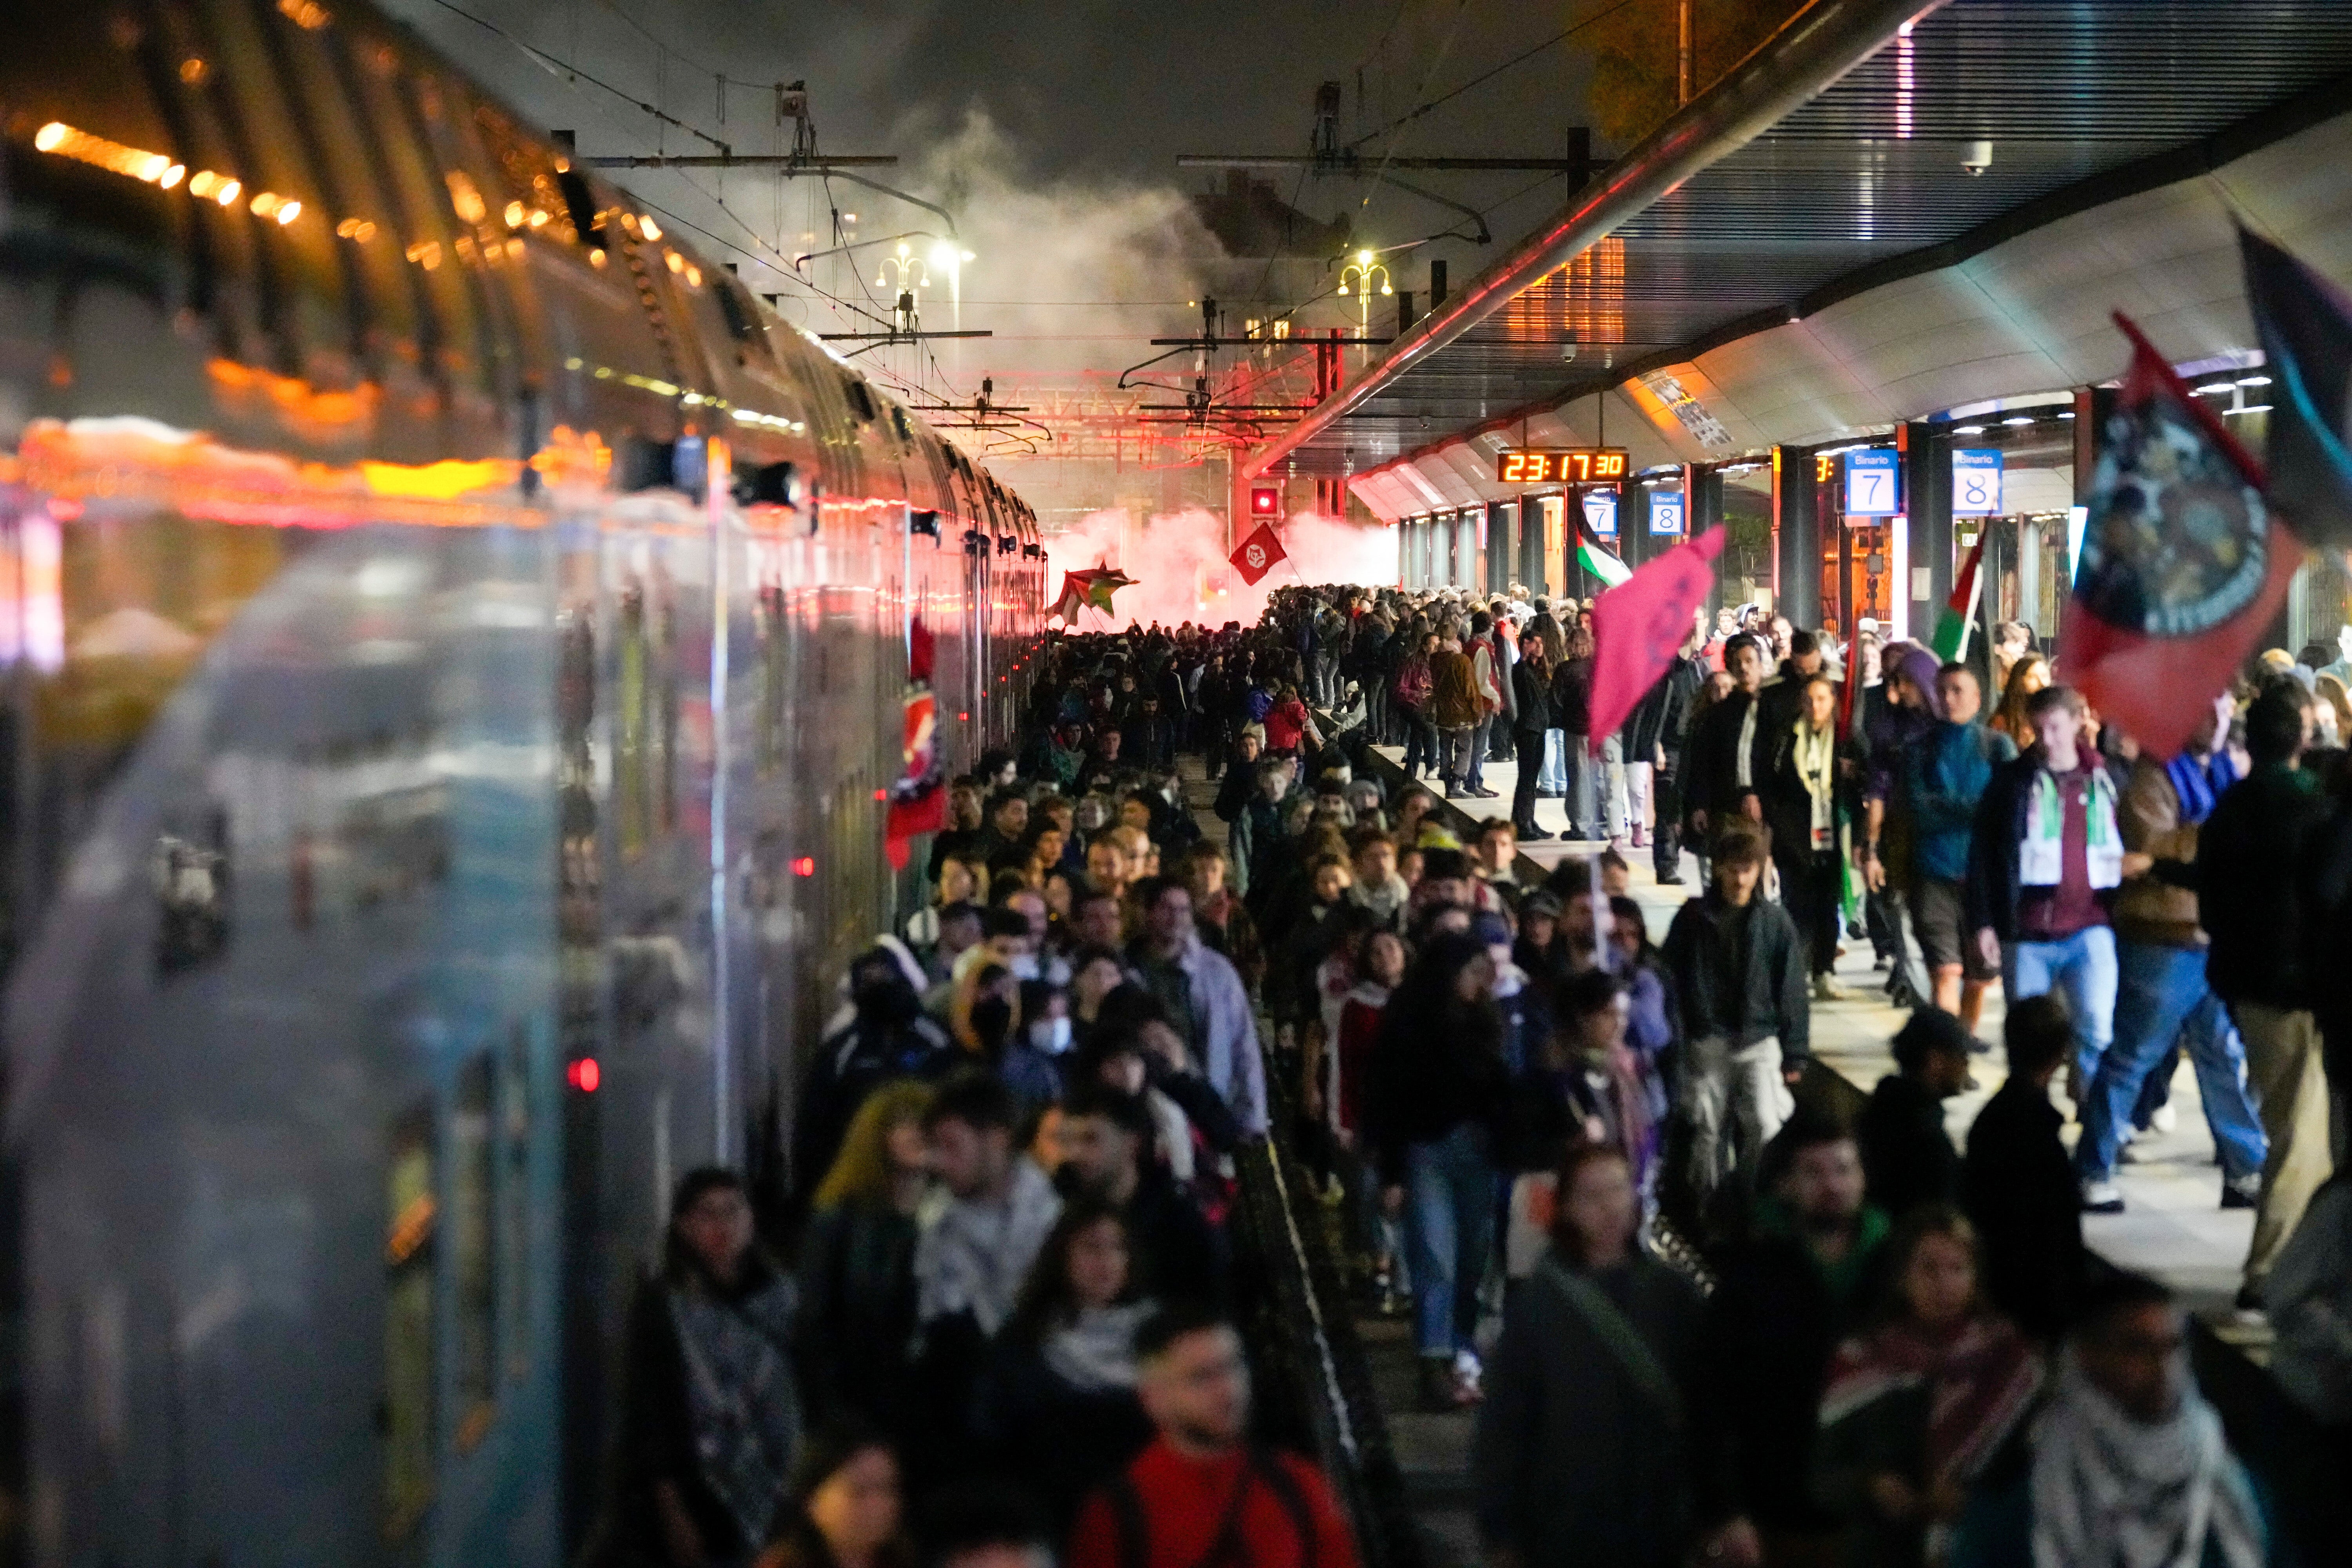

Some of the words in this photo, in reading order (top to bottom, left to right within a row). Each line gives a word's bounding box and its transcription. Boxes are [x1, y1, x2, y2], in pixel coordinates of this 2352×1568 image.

[1596, 456, 1622, 474] 30
[1855, 455, 1889, 465] Binario
[1961, 455, 1993, 464] Binario
[1863, 475, 1881, 505] 7
[1966, 474, 1986, 504] 8
[1594, 508, 1606, 528] 7
[1660, 508, 1673, 528] 8
